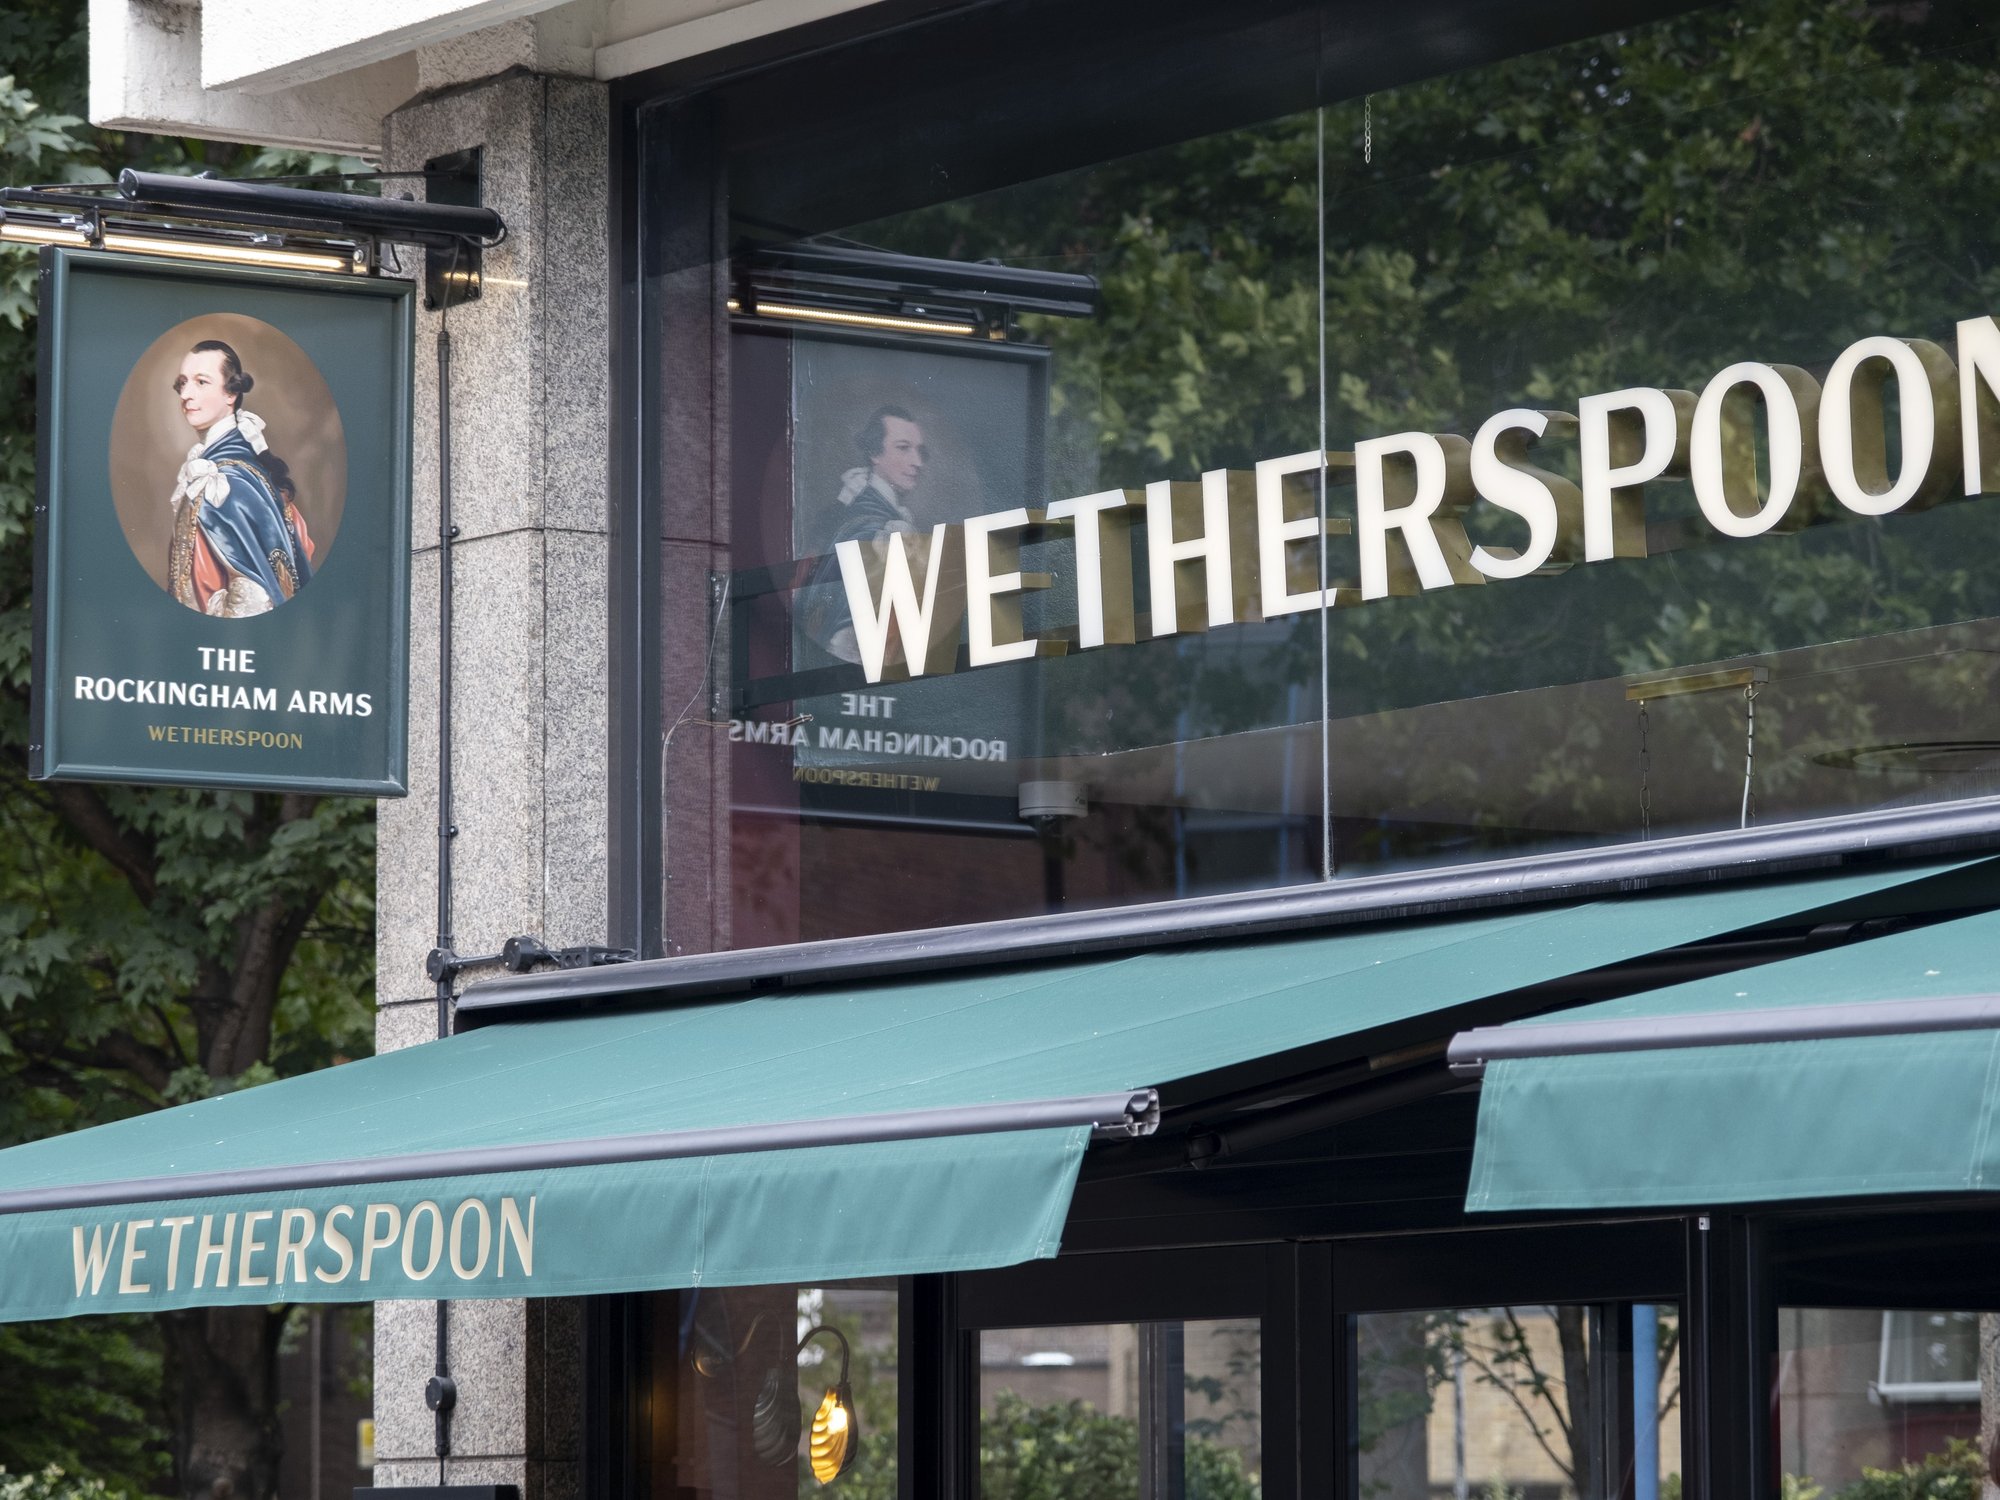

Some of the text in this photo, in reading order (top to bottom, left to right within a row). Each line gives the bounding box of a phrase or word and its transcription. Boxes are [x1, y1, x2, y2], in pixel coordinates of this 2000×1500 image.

[197, 646, 256, 673] THE
[74, 676, 373, 717] ROCKINGHAM ARMS
[148, 725, 303, 749] WETHERSPOON
[72, 1196, 536, 1298] WETHERSPOON
